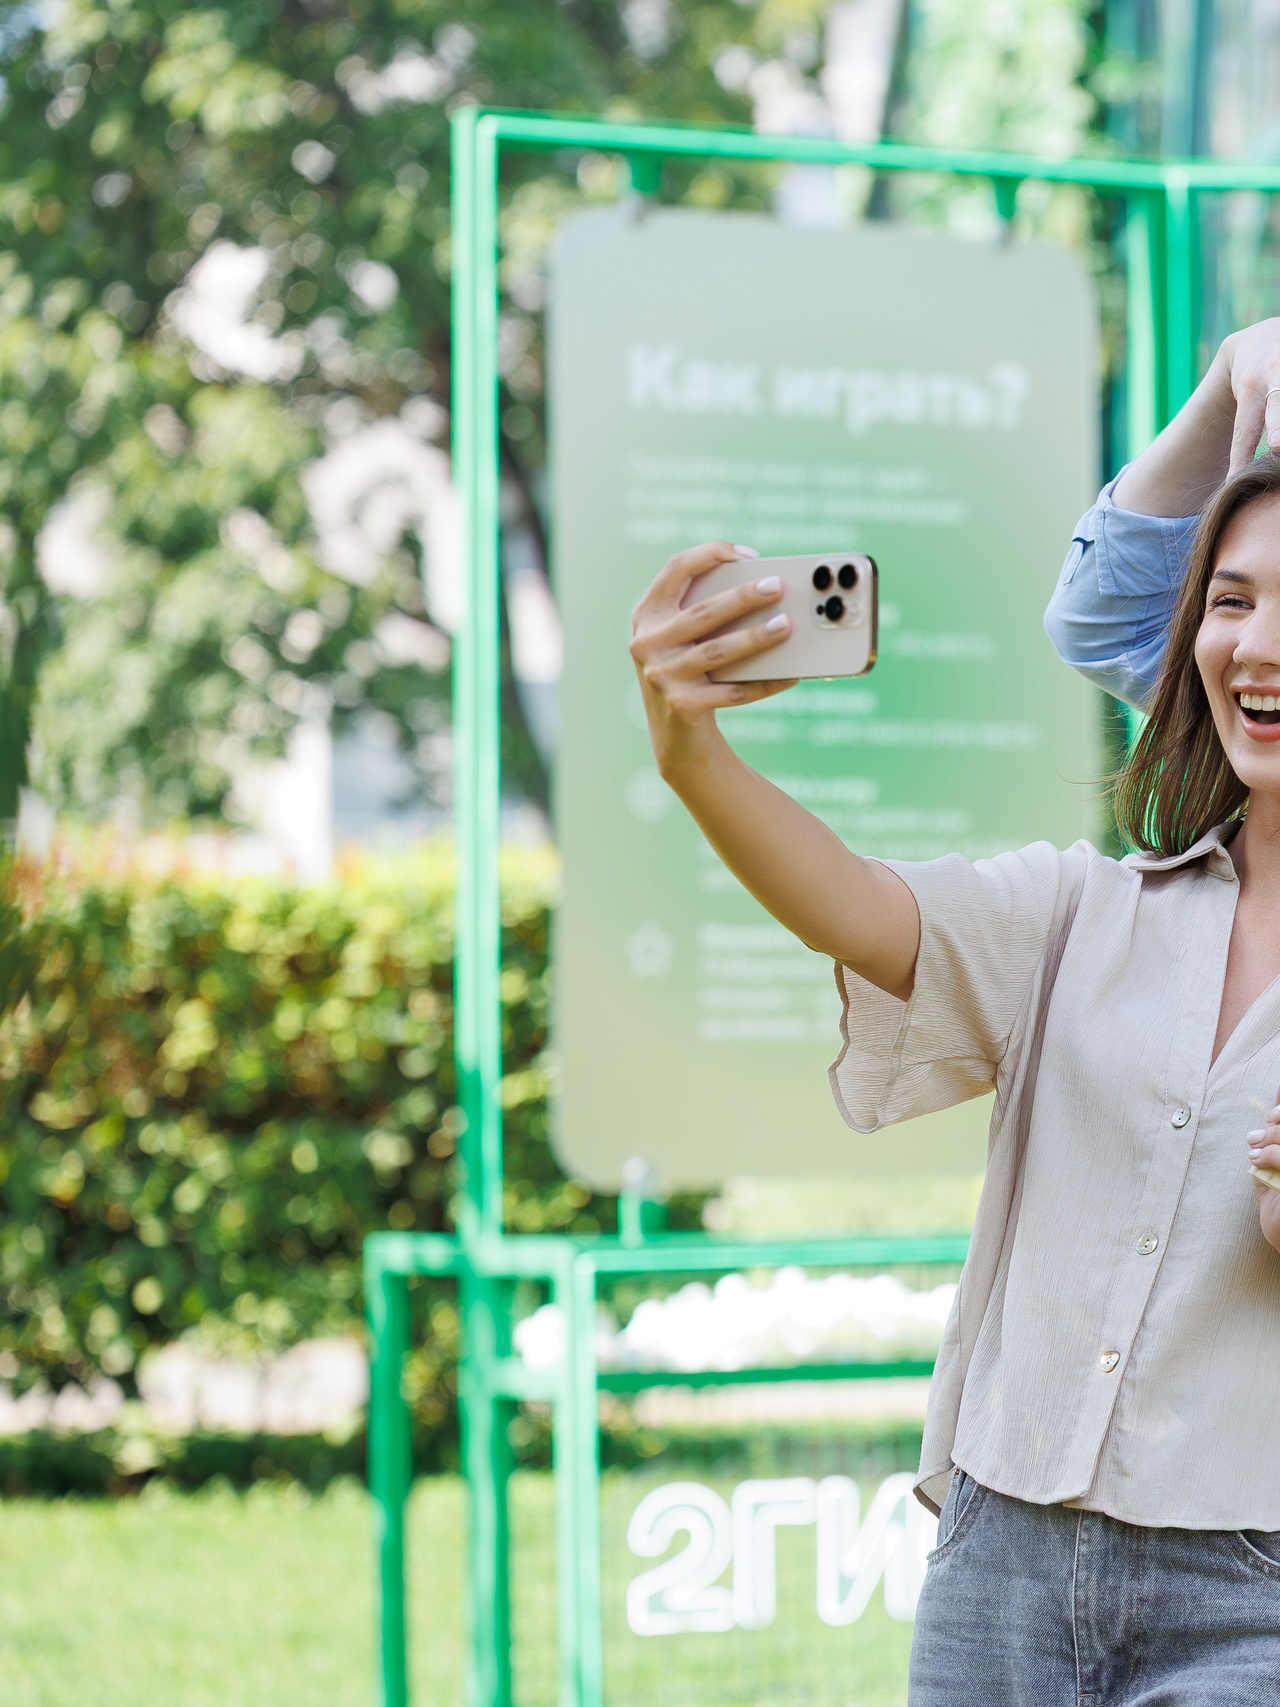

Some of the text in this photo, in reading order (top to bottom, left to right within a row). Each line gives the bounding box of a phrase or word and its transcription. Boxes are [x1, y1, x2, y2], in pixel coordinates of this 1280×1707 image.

[627, 343, 1030, 437] Как играть?
[626, 1472, 938, 1636] 2ГИ
